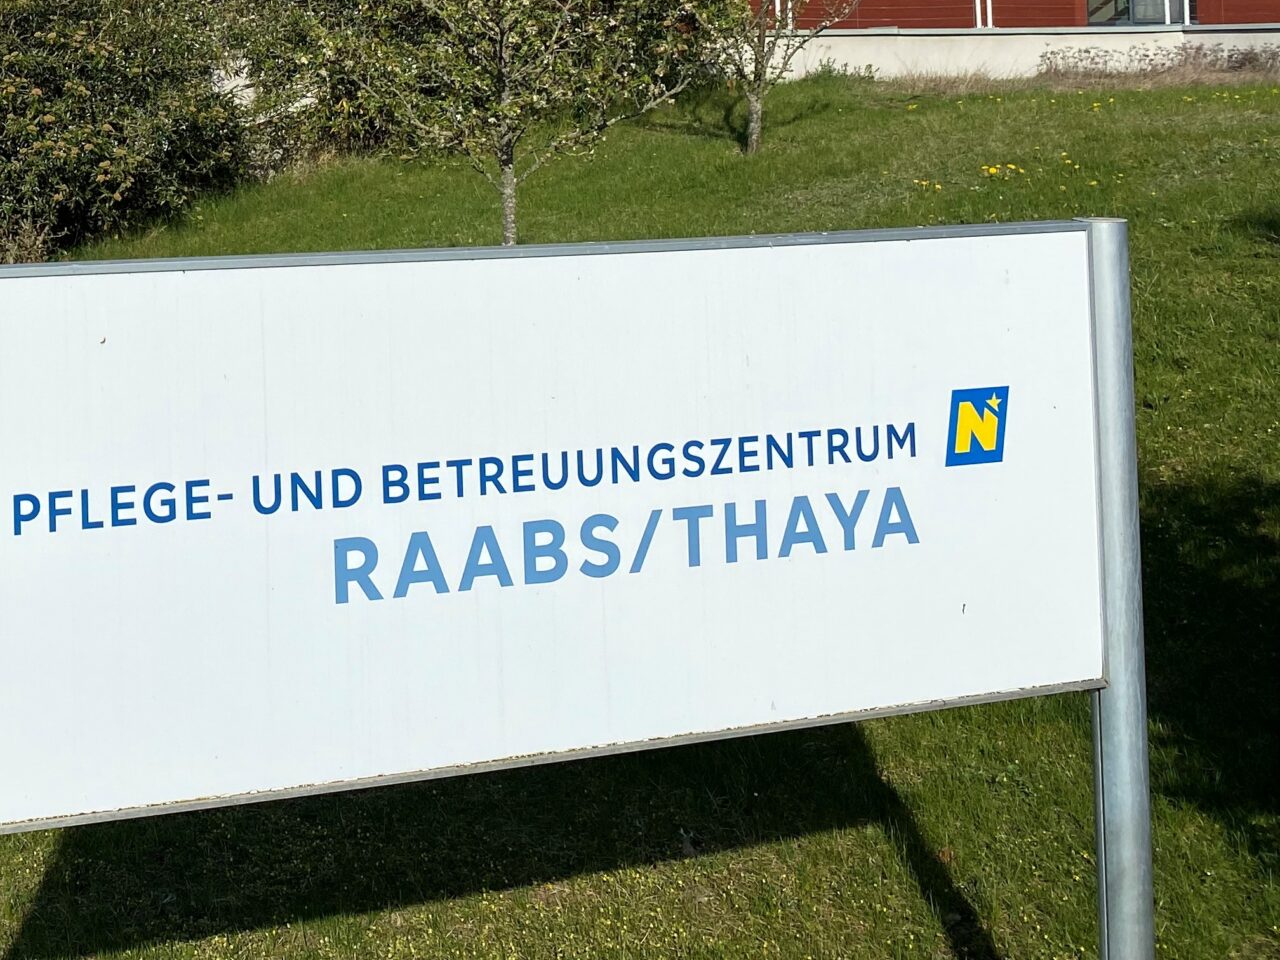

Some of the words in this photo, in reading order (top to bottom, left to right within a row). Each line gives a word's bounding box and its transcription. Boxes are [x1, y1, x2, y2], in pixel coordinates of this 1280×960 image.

[12, 479, 233, 537] PFLEGE-
[251, 467, 363, 516] UND
[381, 422, 917, 505] BETREUUNGSZENTRUM
[333, 487, 920, 605] RAABS/THAYA
